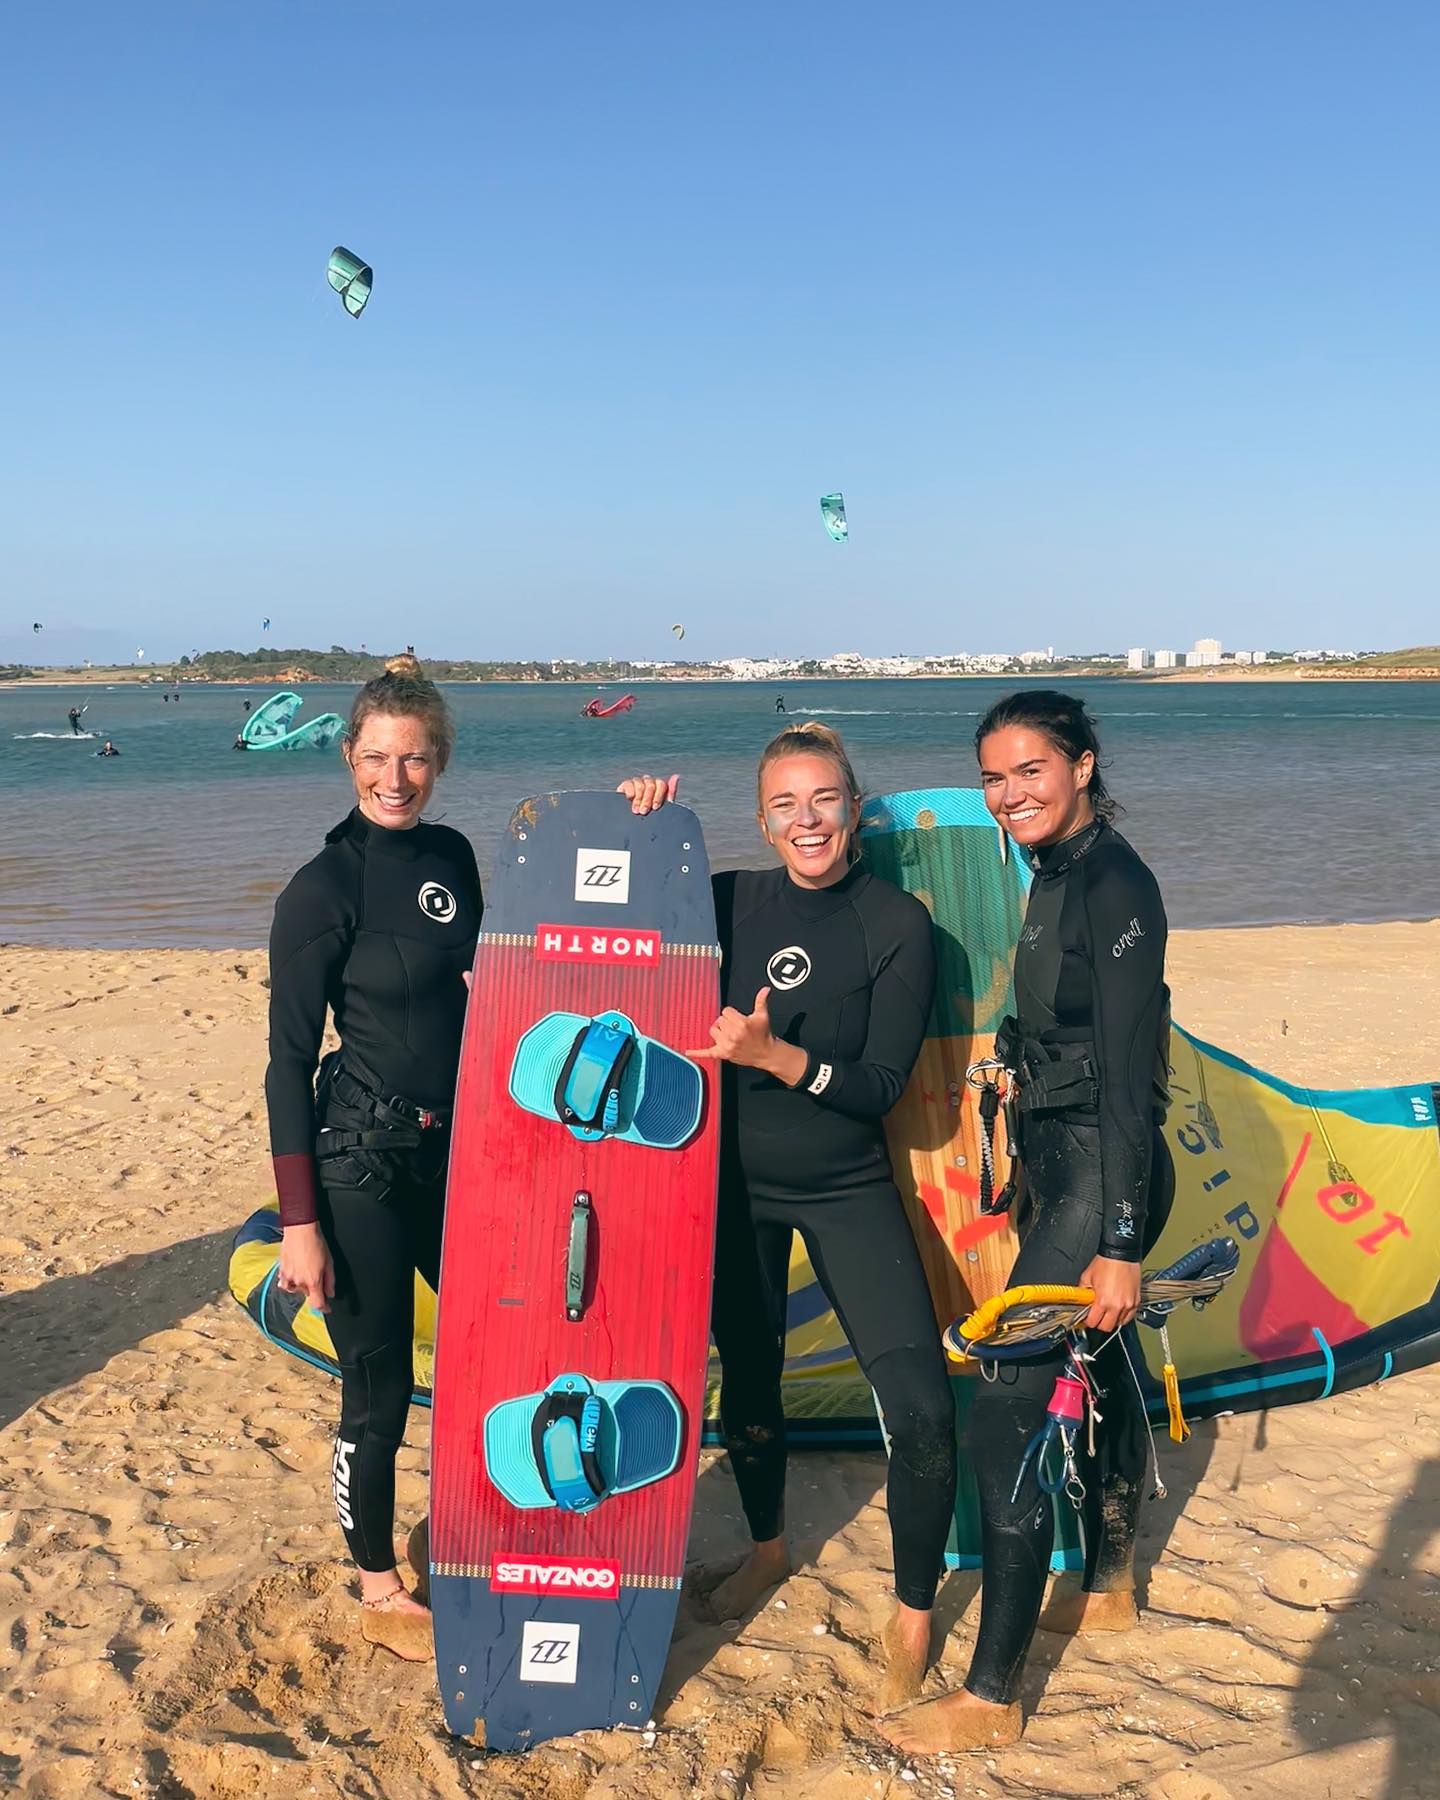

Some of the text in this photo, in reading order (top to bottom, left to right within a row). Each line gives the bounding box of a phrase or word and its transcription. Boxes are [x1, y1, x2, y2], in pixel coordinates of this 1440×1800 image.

[544, 933, 653, 957] NORTH
[1316, 1181, 1412, 1256] 10
[496, 1562, 616, 1588] GONZALES
